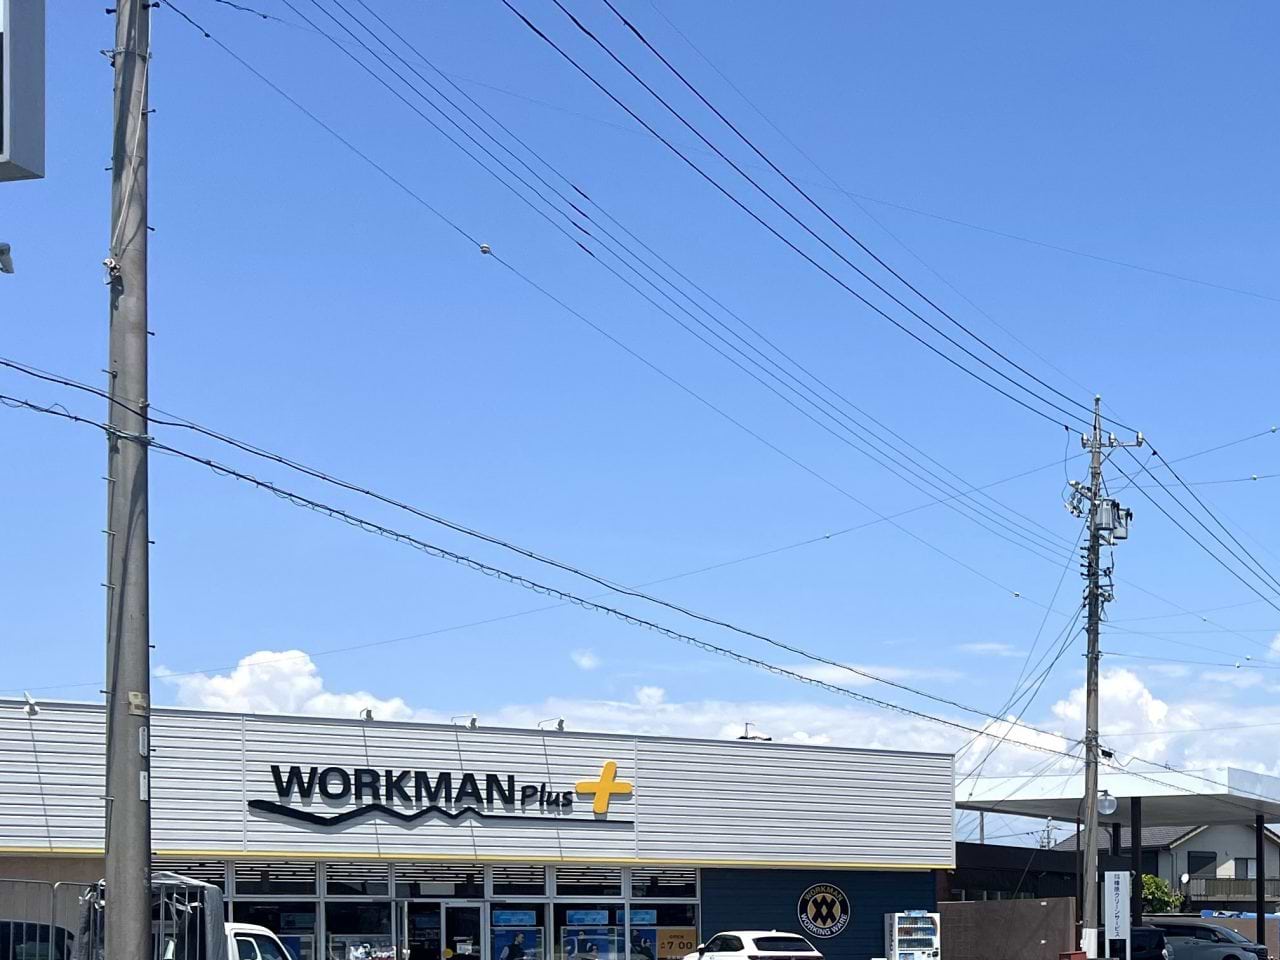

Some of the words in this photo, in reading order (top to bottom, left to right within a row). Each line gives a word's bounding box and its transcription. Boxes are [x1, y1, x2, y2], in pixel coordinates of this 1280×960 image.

[270, 764, 515, 804] WORKMAN
[521, 782, 574, 808] Plus
[804, 886, 844, 901] WORKMAN
[801, 913, 831, 935] WORKING
[830, 913, 848, 933] WARE
